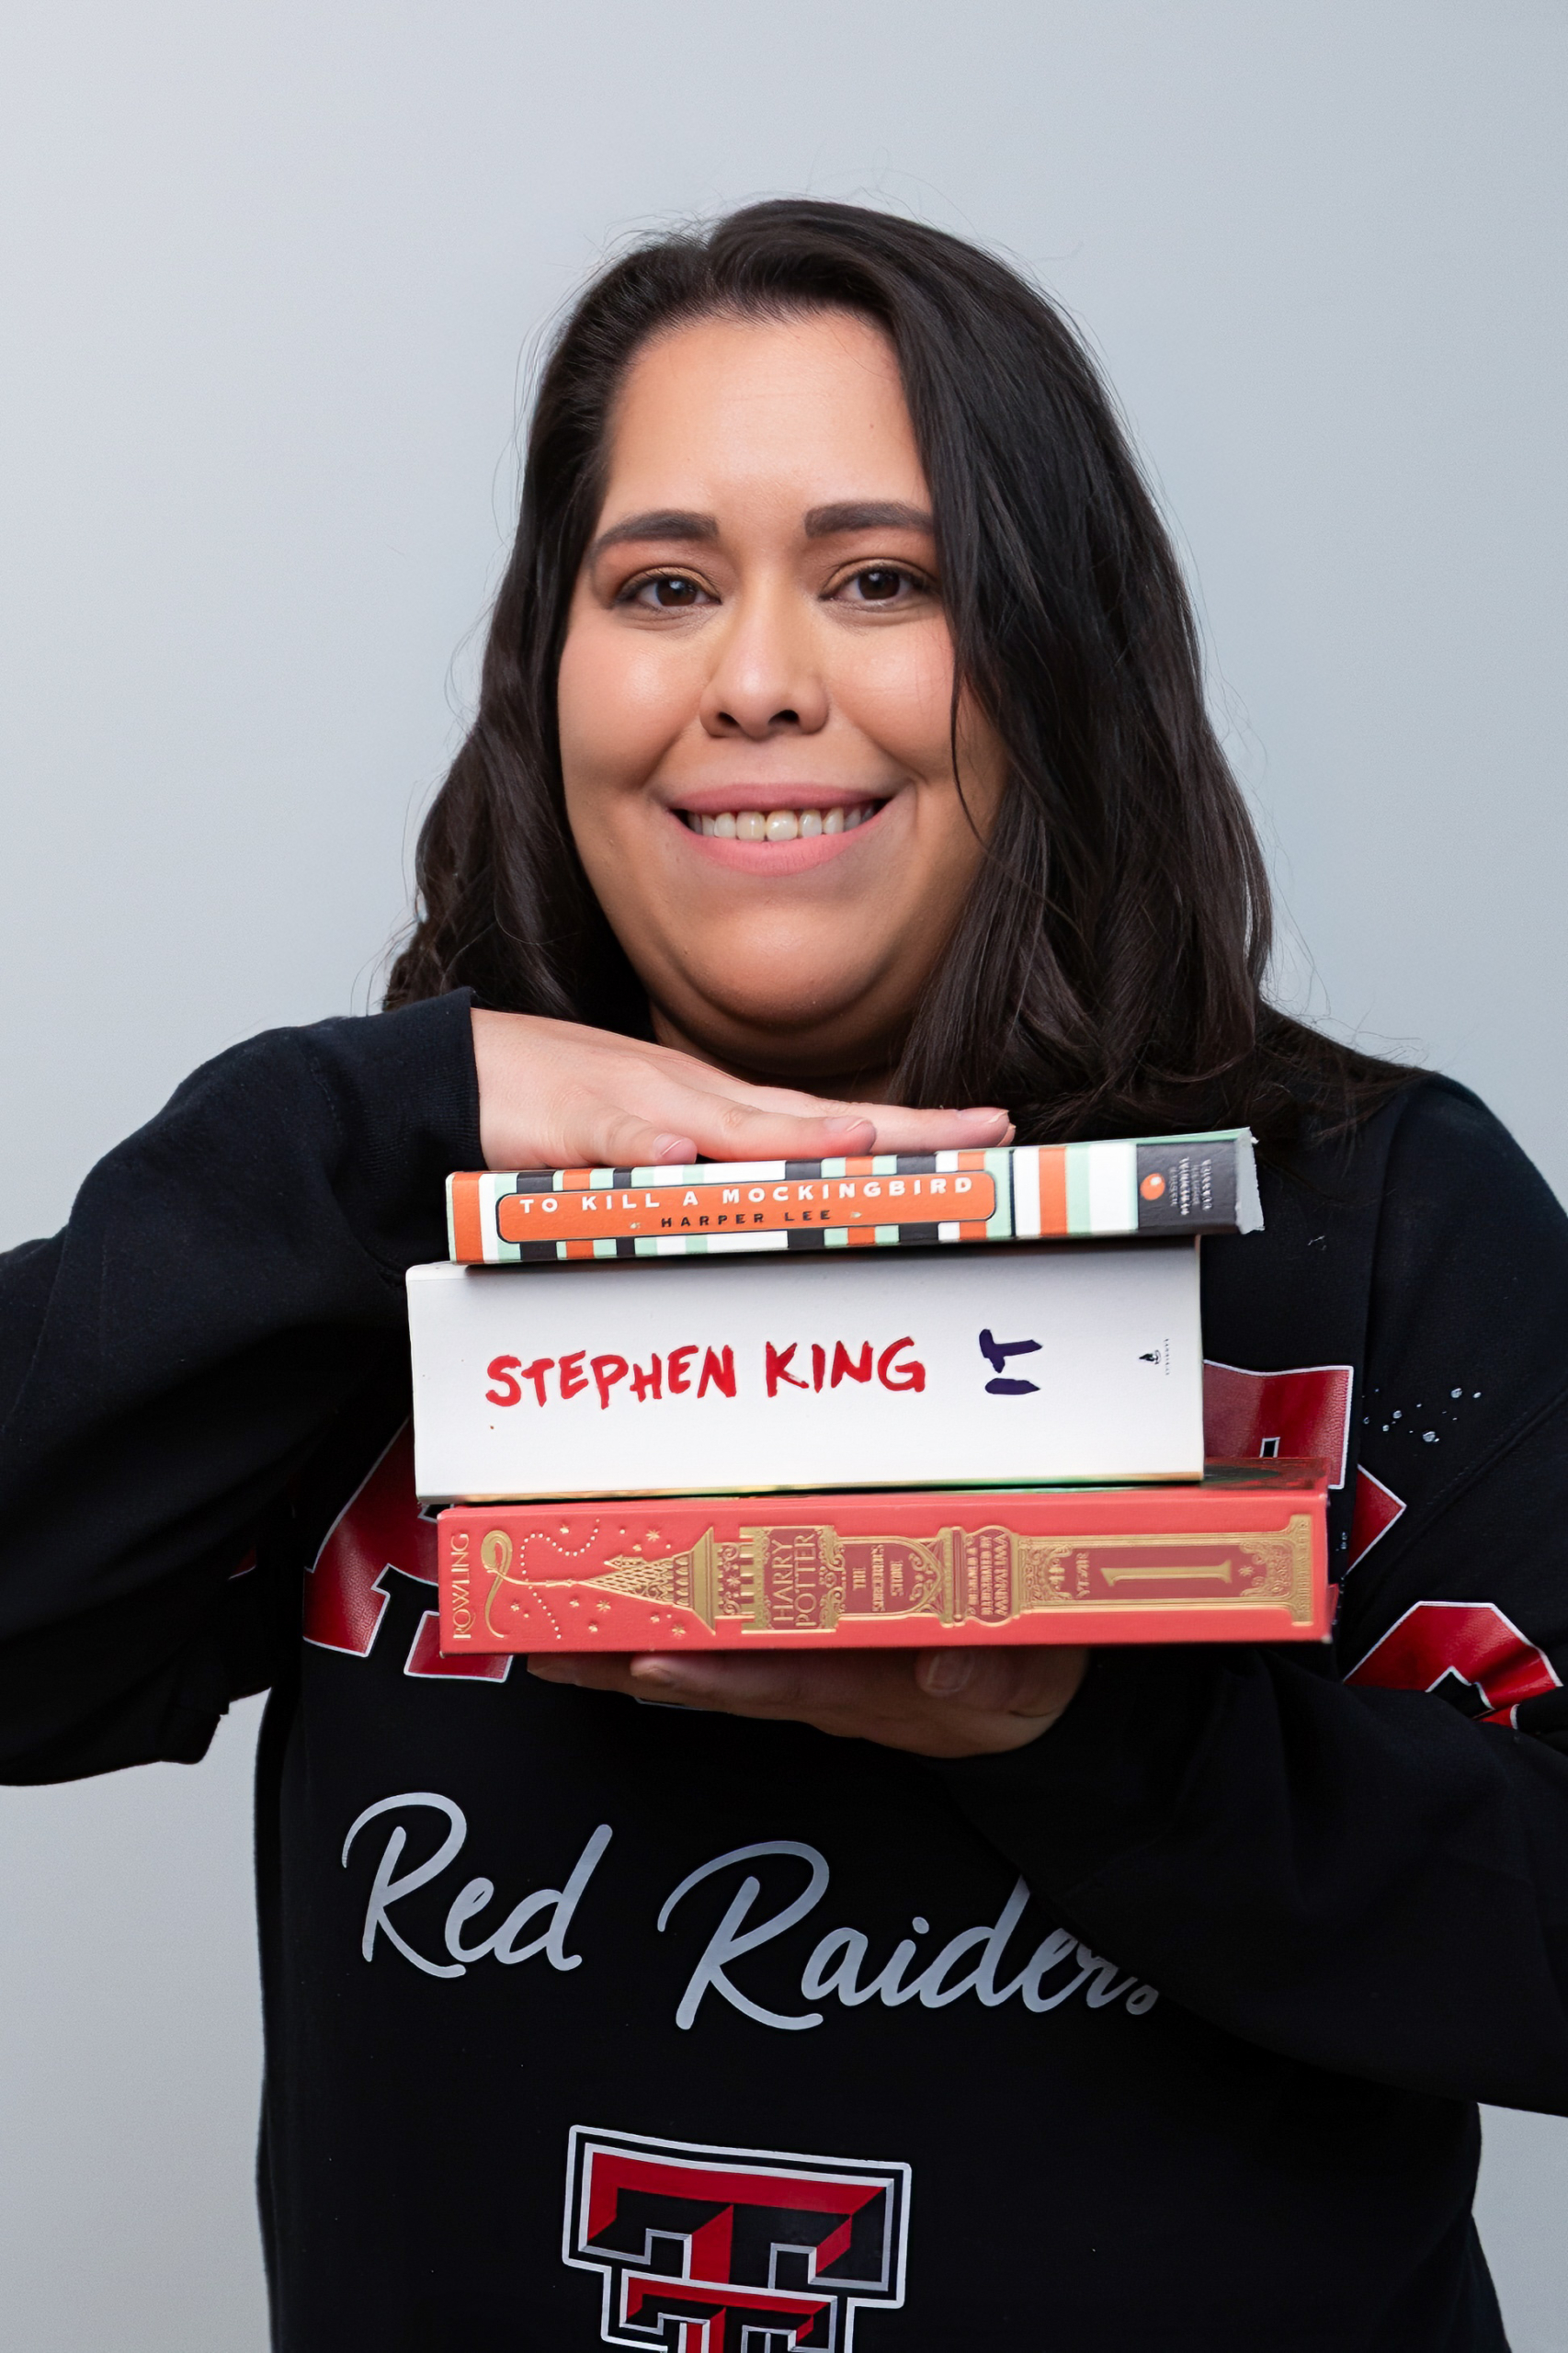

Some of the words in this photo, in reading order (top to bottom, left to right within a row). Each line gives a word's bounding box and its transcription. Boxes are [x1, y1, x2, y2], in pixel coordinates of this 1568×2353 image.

[519, 1198, 558, 1214] TO
[581, 1190, 660, 1211] KILL
[683, 1190, 699, 1206] A
[722, 1176, 972, 1205] MOCKINGBIRD
[661, 1211, 764, 1229] HARPER
[785, 1209, 830, 1222] LEE
[485, 1344, 737, 1410] STEPHEN
[765, 1336, 926, 1399] KING
[978, 1328, 1043, 1395] IT
[449, 1533, 475, 1640] ROWLING
[770, 1539, 794, 1621] HARRY
[794, 1534, 817, 1627] POTTER
[341, 1791, 613, 1979] Red
